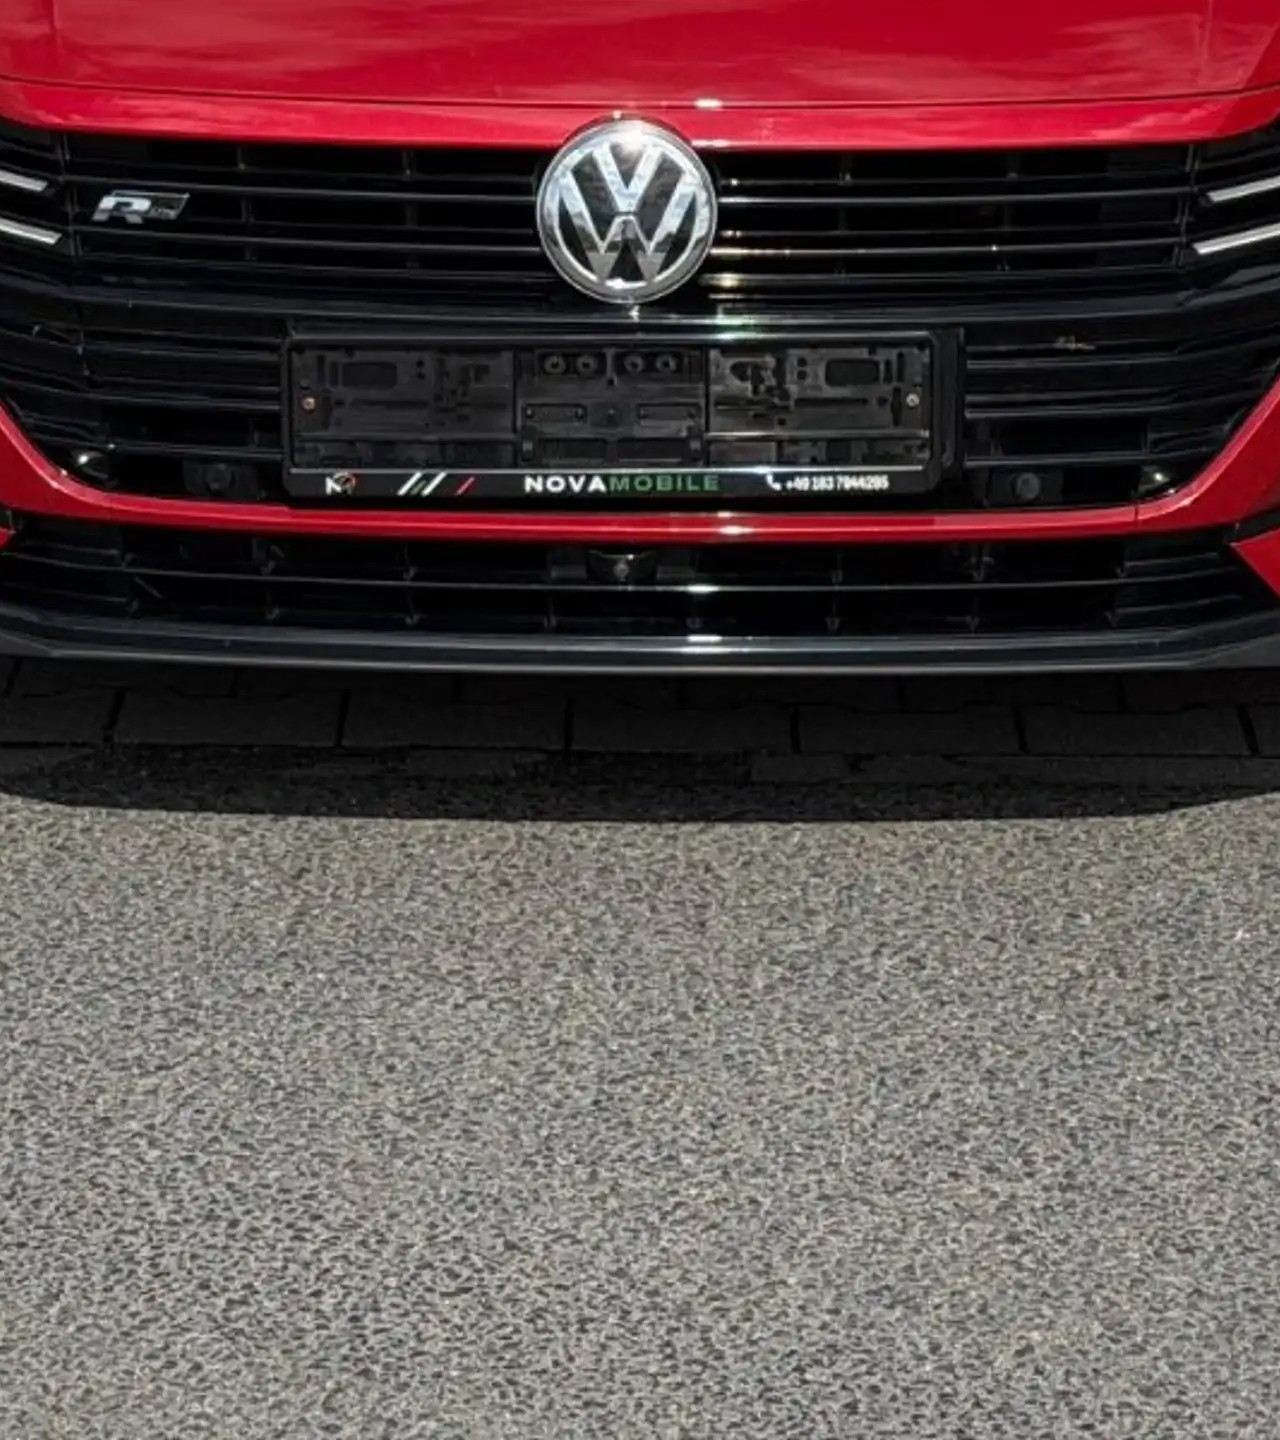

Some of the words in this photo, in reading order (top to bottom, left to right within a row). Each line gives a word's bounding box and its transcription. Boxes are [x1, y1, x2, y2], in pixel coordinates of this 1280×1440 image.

[92, 196, 151, 224] R
[547, 128, 708, 295] VW
[524, 474, 719, 493] NOVAMOBILE
